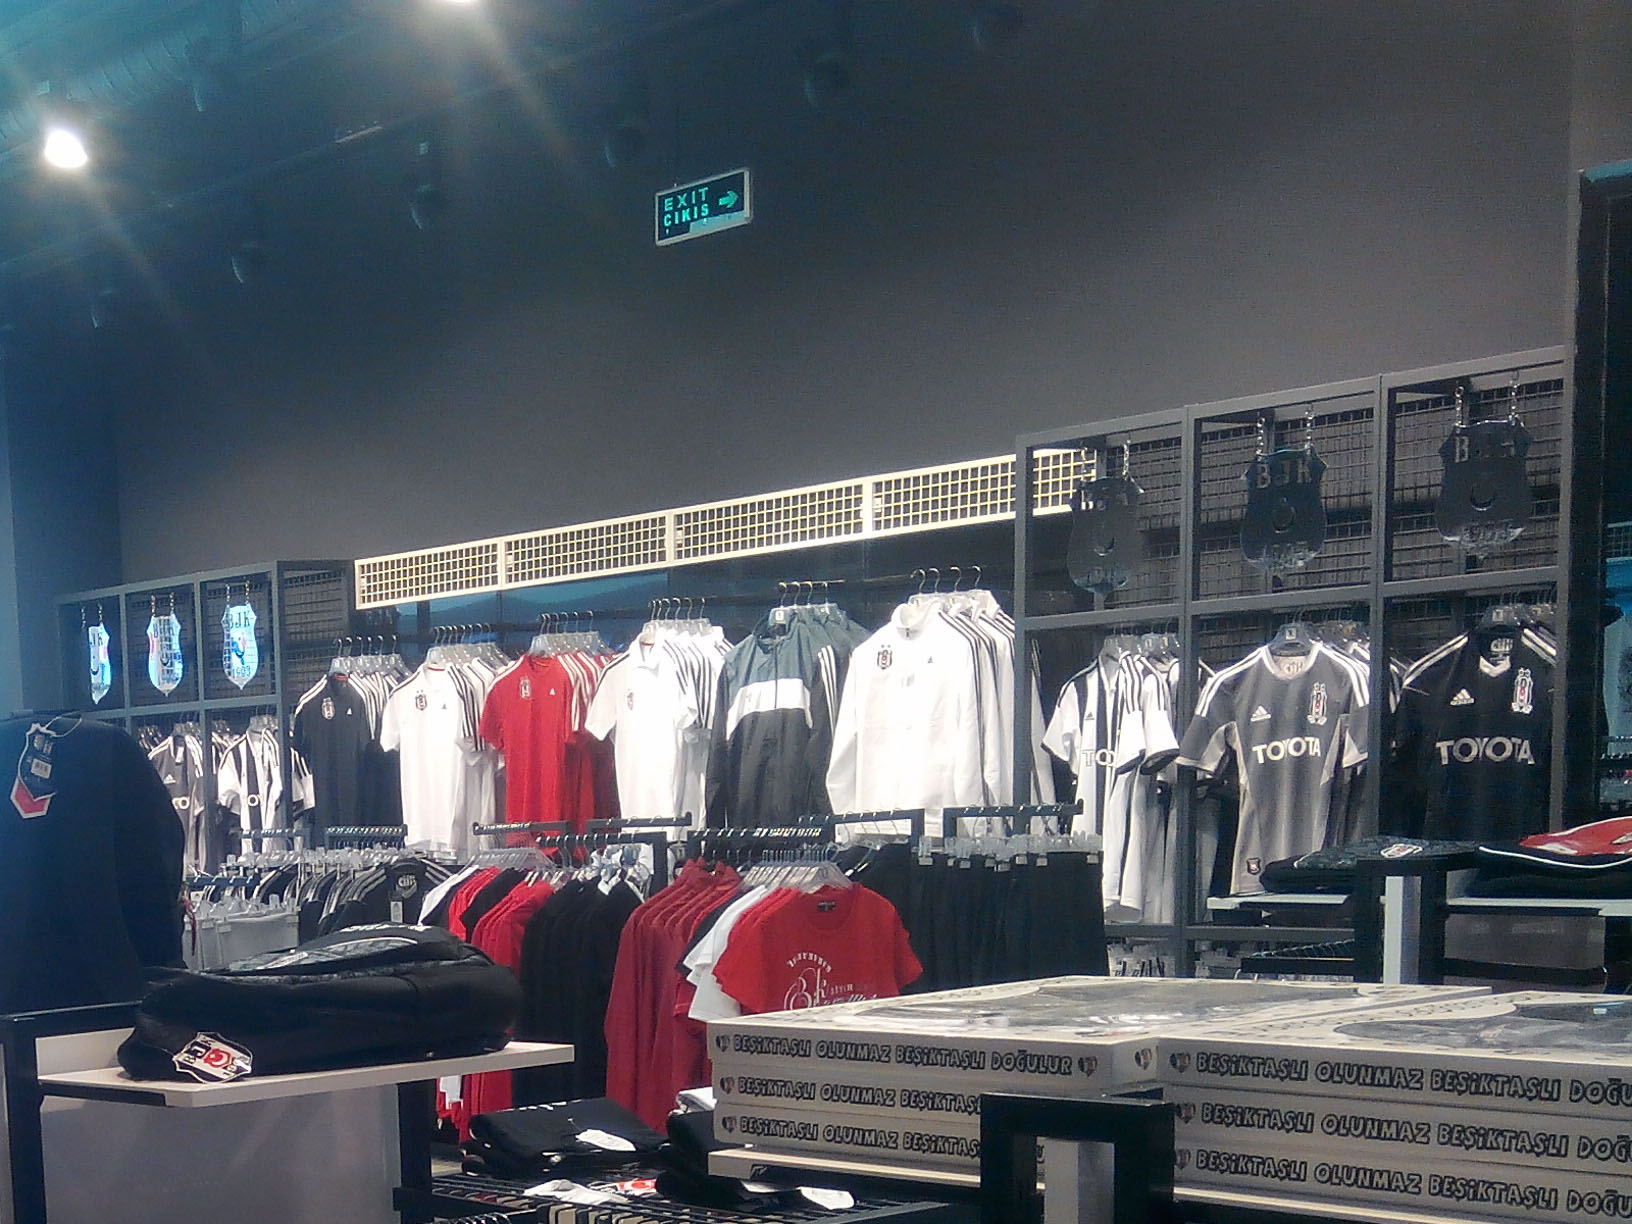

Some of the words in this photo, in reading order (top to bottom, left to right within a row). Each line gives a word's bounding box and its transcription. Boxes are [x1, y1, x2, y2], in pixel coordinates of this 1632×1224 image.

[664, 187, 709, 212] EXIT
[1252, 737, 1321, 765] TOYOTA
[1435, 736, 1536, 766] TOYOTA
[816, 1042, 892, 1063] OLUNMAZ
[992, 1049, 1072, 1076] DOĞULUR
[1315, 1060, 1424, 1090] OLUNMAZ
[821, 1083, 896, 1107] OLUNMAZ
[900, 1088, 981, 1116] BEŞİKTAŞ
[823, 1124, 899, 1149] OLUNMAZ
[902, 1131, 980, 1159] BEŞİKTAŞ
[1320, 1113, 1430, 1145] OLUNMAZ
[1577, 1135, 1632, 1163] DOĞ
[1313, 1161, 1422, 1196] OLUNMAZ
